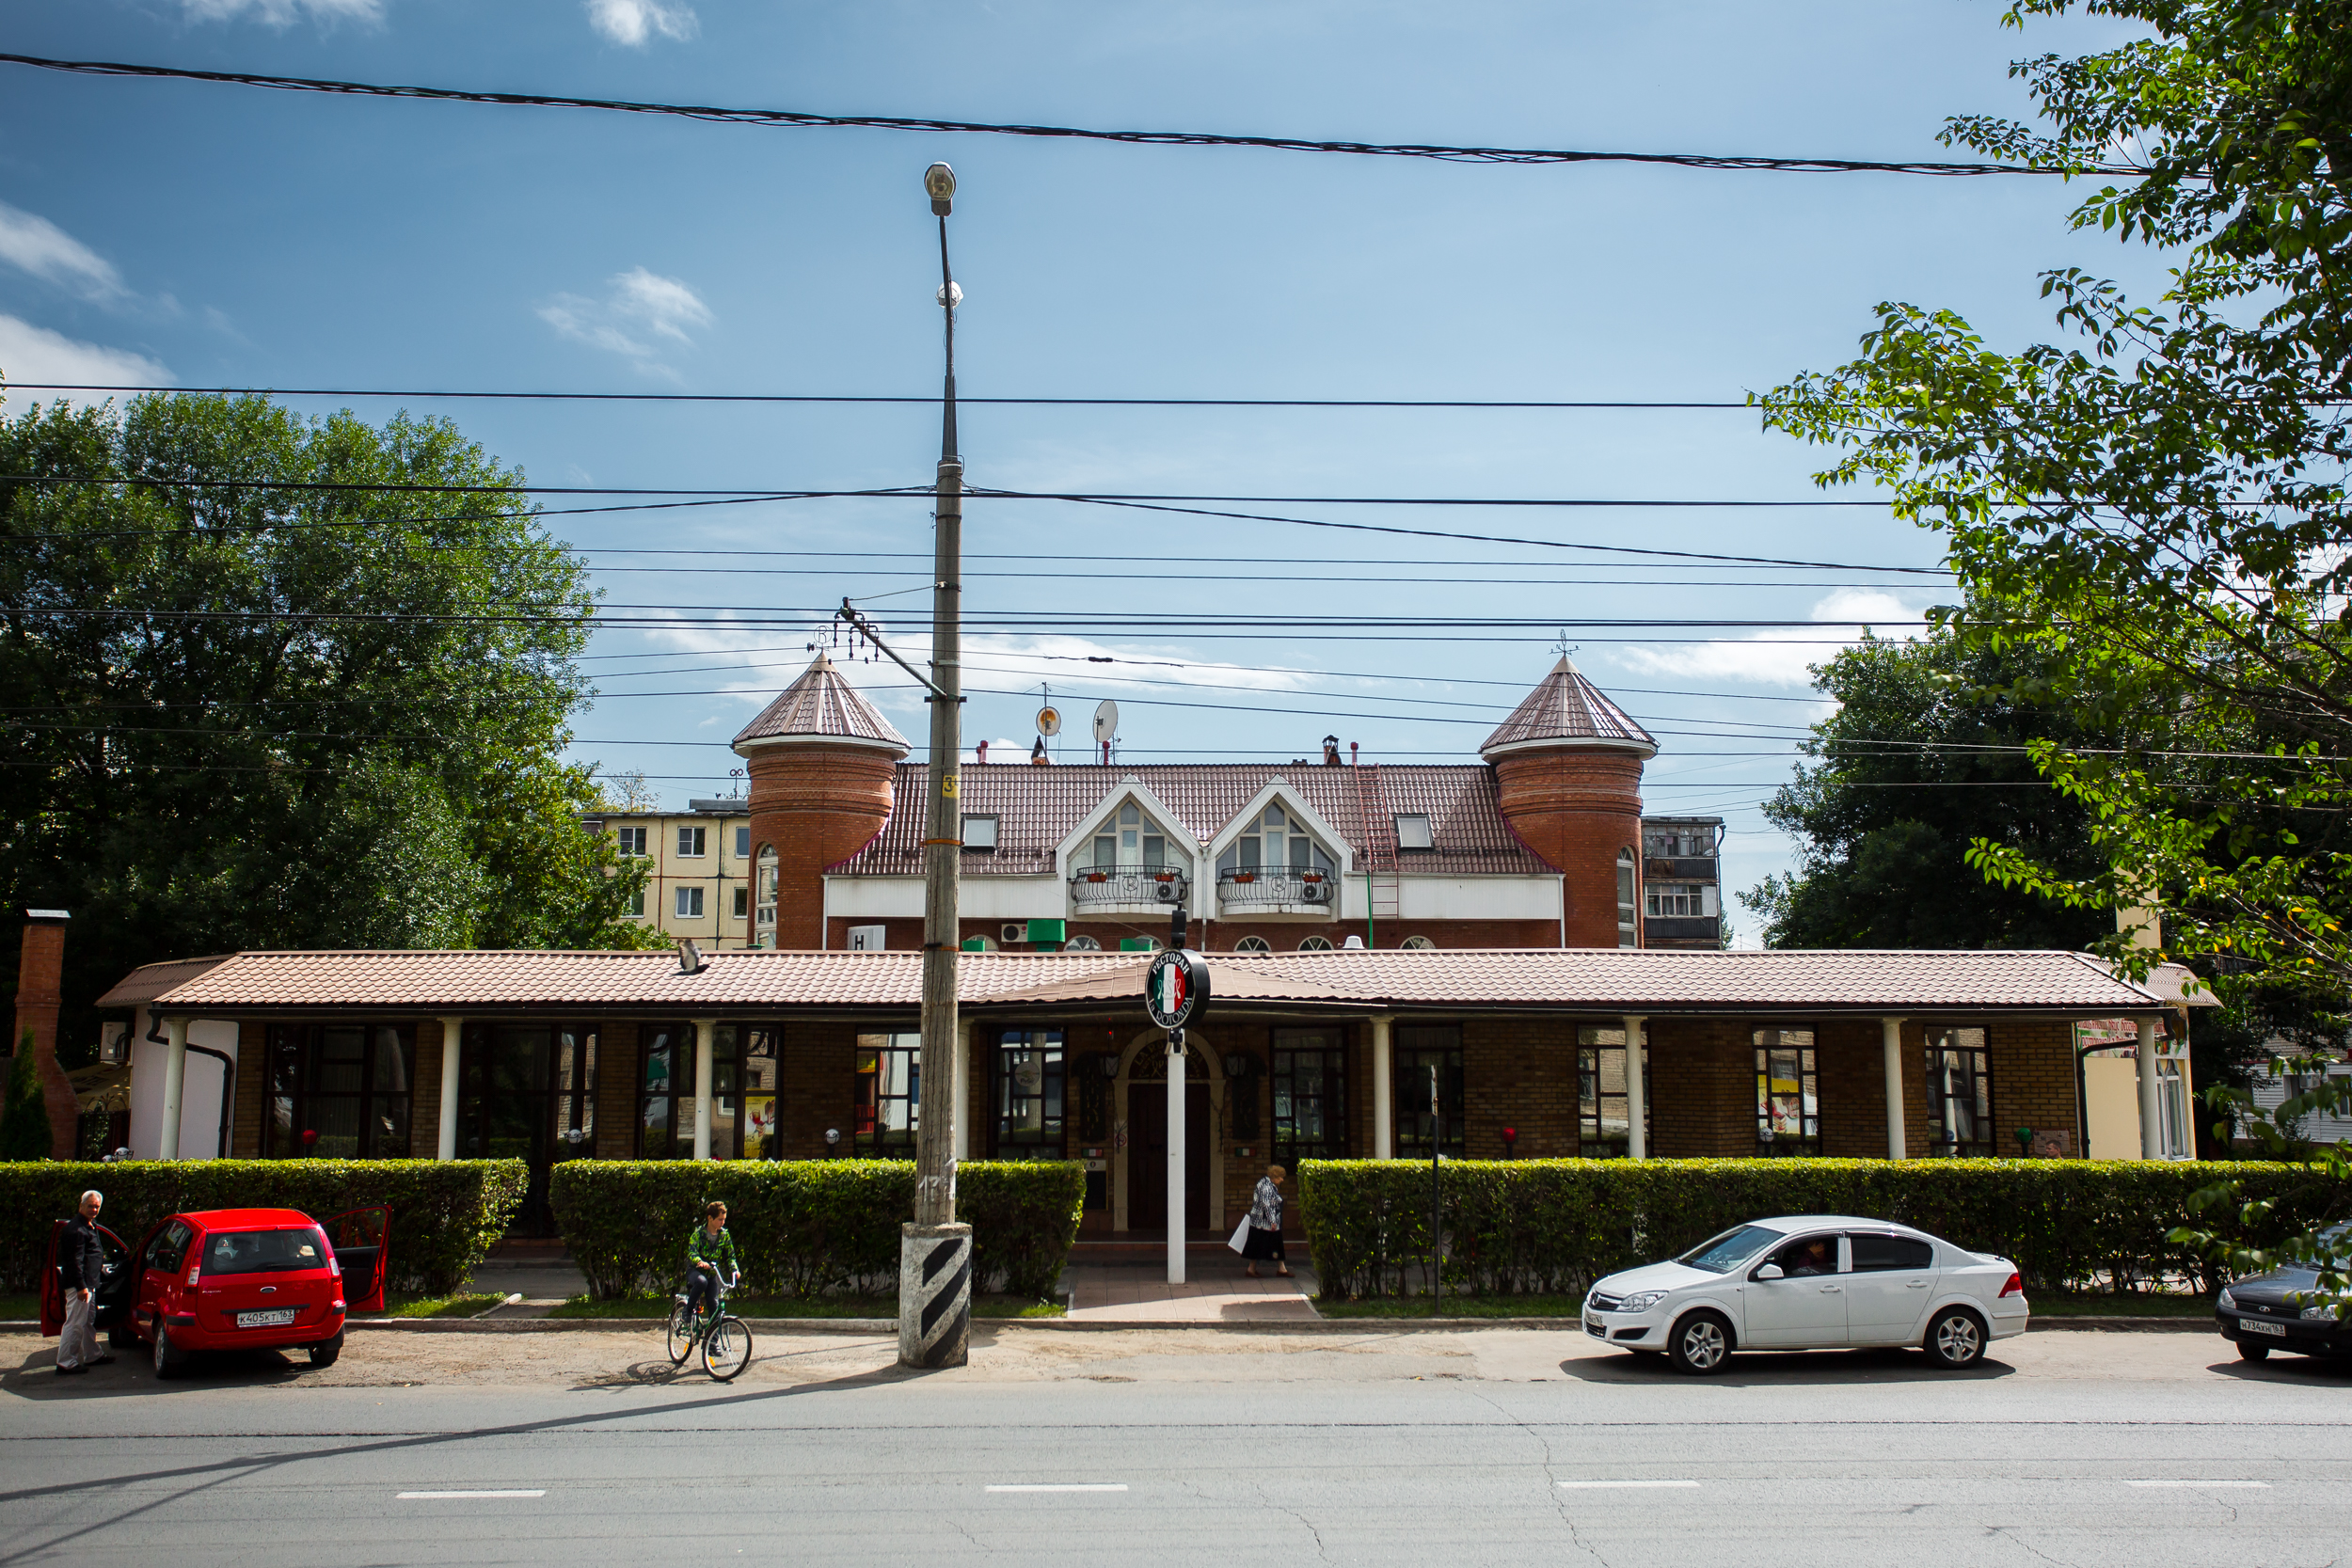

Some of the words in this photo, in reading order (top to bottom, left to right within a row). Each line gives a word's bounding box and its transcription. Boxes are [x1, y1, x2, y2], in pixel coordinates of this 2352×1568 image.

[1152, 952, 1190, 975] РЕСТОРАН
[1156, 997, 1193, 1025] ROTONDA
[239, 1312, 277, 1323] К405КТ
[278, 1309, 294, 1319] 163
